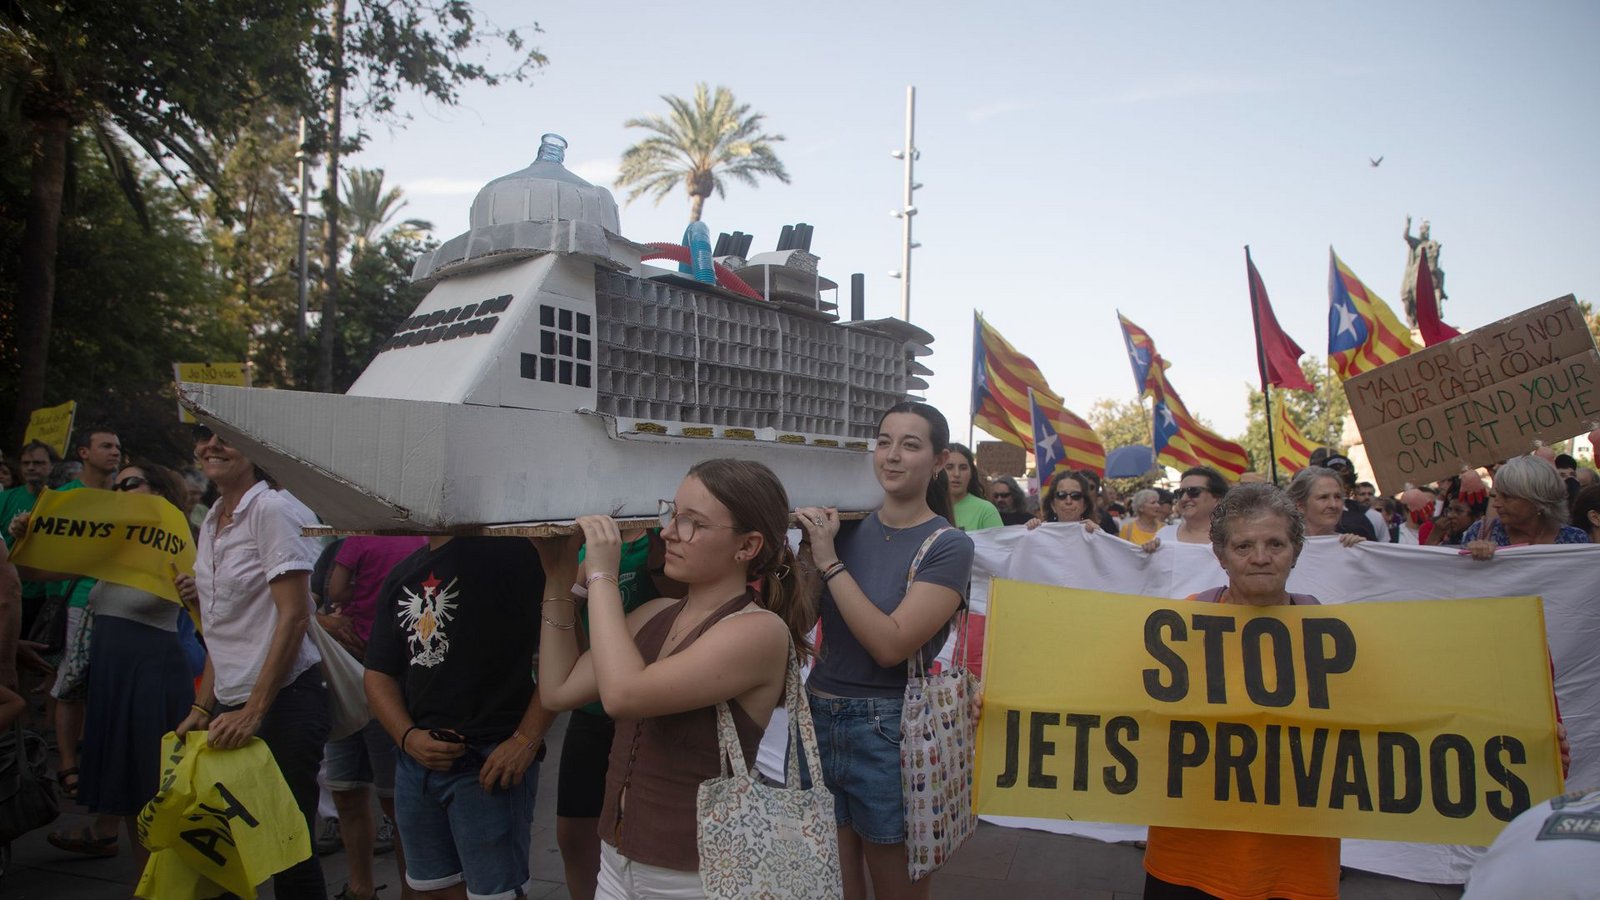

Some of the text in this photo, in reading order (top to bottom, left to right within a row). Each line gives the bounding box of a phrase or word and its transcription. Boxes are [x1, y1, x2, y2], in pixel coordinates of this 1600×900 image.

[1357, 306, 1577, 405] MALLORCA IS NOT
[1373, 388, 1437, 424] YOUR
[1439, 365, 1496, 401] CASH
[1397, 363, 1593, 446] GO FIND YOUR
[1397, 389, 1600, 474] OWN AT HOME
[32, 515, 115, 538] MENYS
[1142, 609, 1357, 709] STOP
[996, 709, 1531, 822] JETS PRIVADOS
